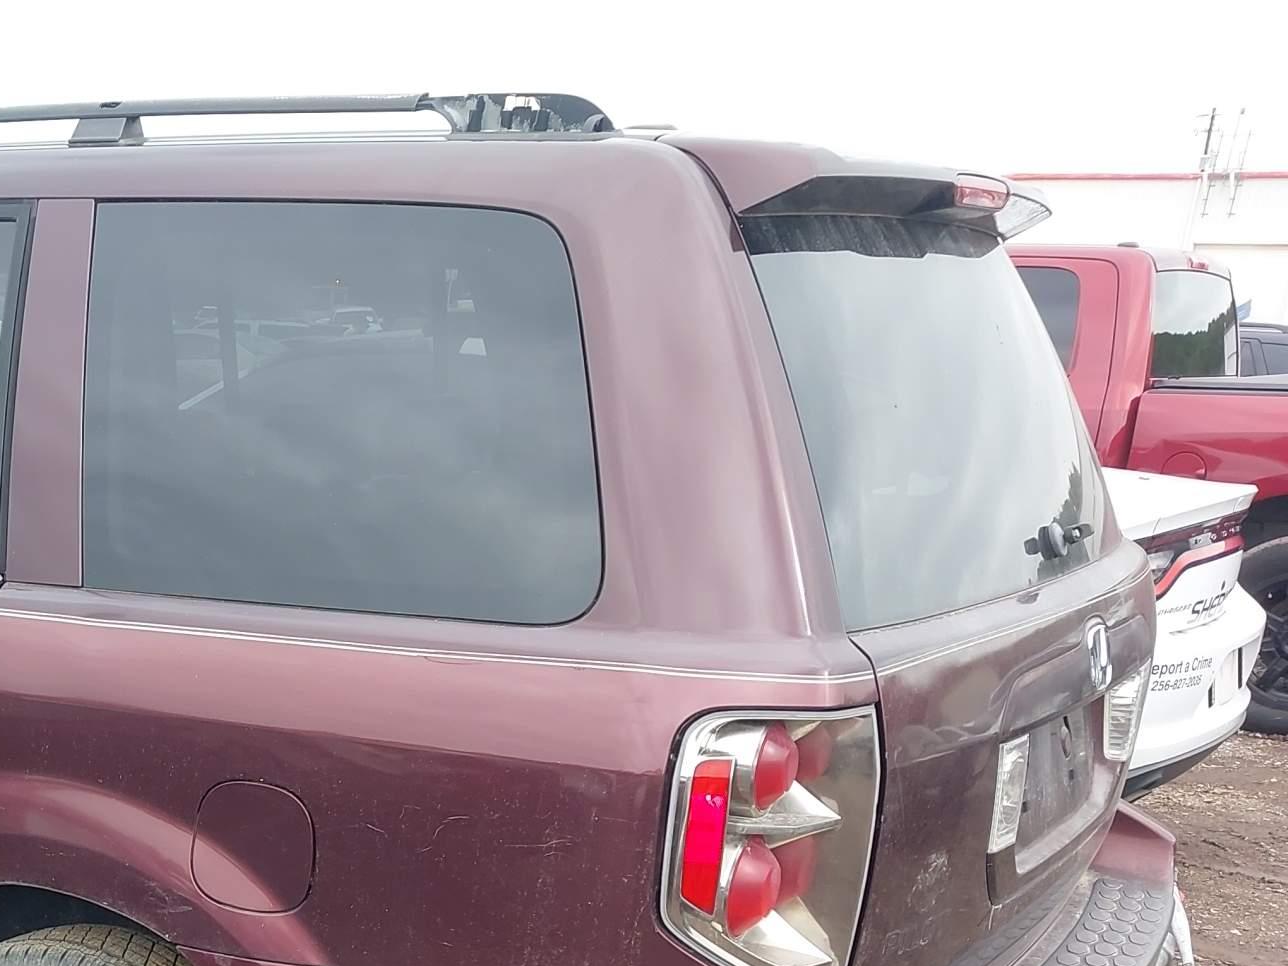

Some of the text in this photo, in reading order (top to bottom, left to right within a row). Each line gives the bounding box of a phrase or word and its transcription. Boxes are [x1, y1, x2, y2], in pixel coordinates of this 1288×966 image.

[1151, 656, 1213, 679] eport a Crime
